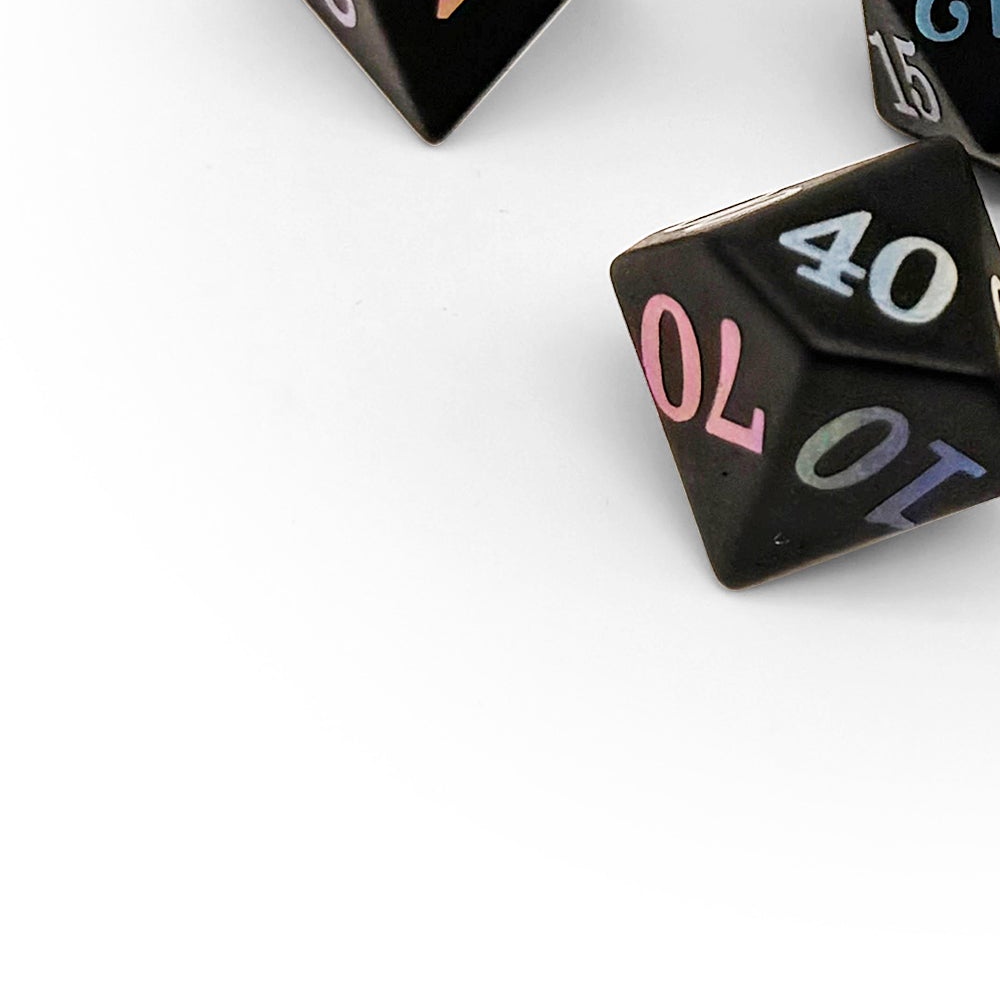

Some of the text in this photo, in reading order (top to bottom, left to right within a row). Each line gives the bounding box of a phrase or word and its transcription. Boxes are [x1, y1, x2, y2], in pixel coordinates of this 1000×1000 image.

[869, 31, 940, 122] 15
[778, 210, 958, 325] 40
[641, 294, 765, 454] 70
[795, 406, 987, 530] 10
